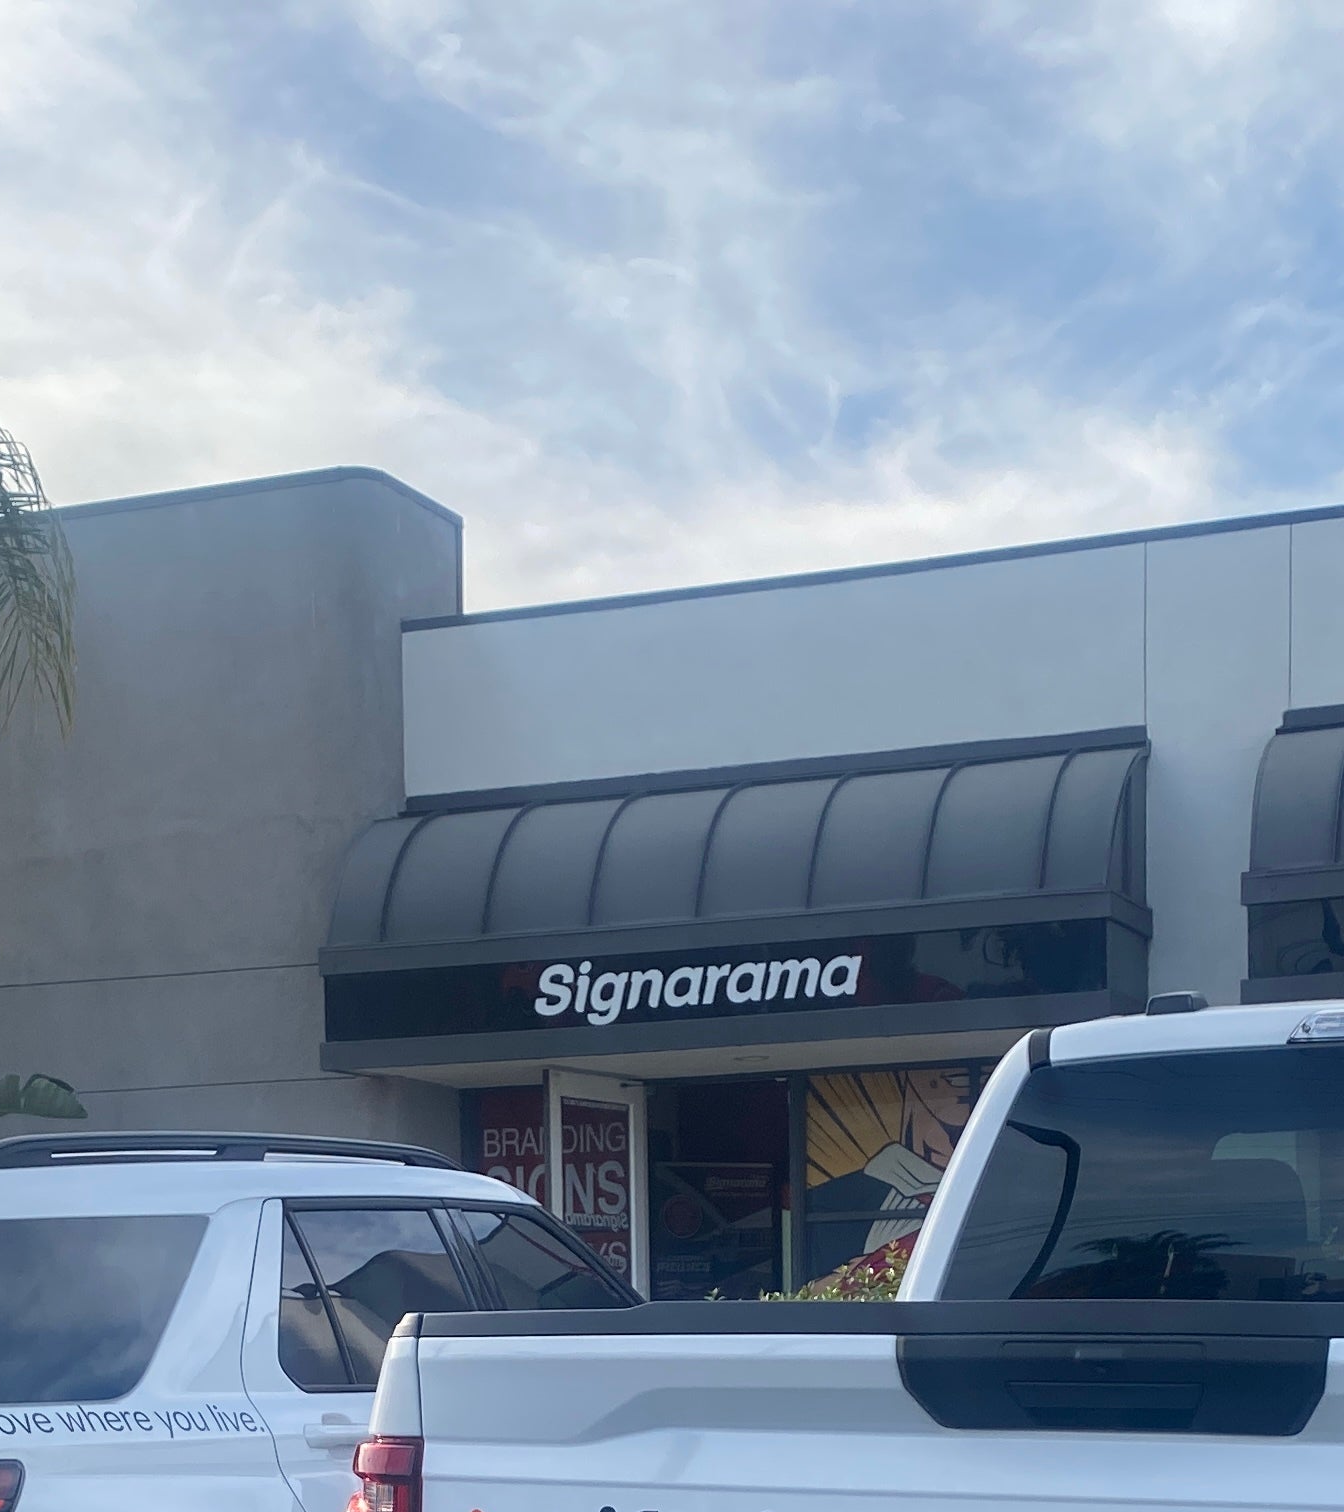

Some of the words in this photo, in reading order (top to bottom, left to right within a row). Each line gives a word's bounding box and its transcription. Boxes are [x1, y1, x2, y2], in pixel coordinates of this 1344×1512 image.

[534, 955, 862, 1026] Signarama
[55, 1403, 154, 1434] where
[154, 1409, 210, 1439] you
[205, 1403, 265, 1433] live.
